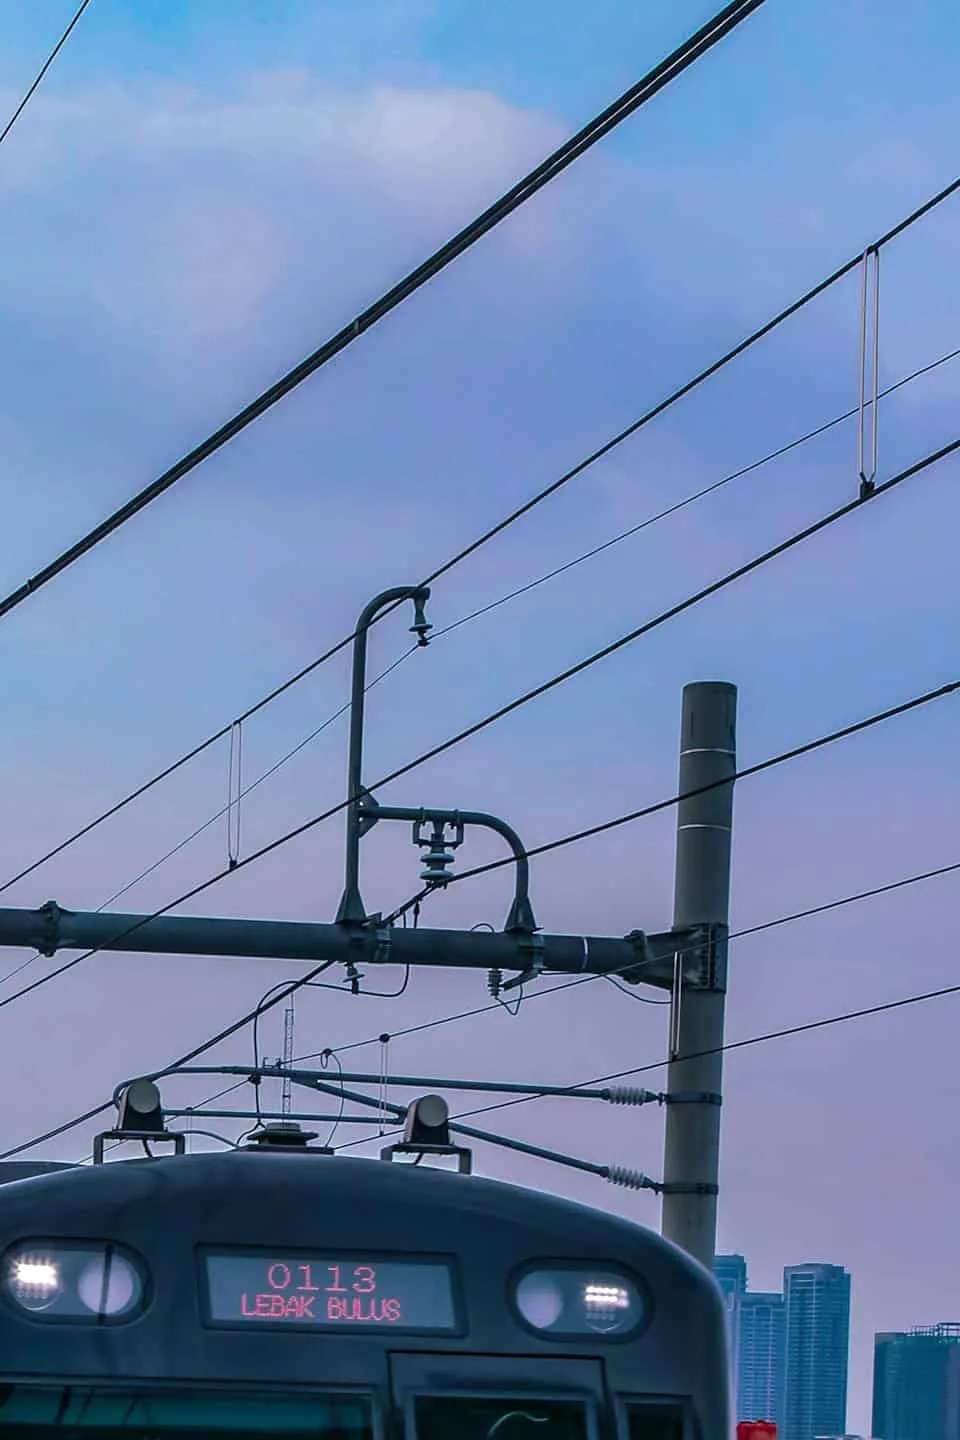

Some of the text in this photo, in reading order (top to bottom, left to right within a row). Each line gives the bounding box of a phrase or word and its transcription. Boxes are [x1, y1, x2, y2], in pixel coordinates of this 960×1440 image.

[267, 1263, 376, 1293] 0113
[241, 1293, 401, 1321] LEBAK BULUS
